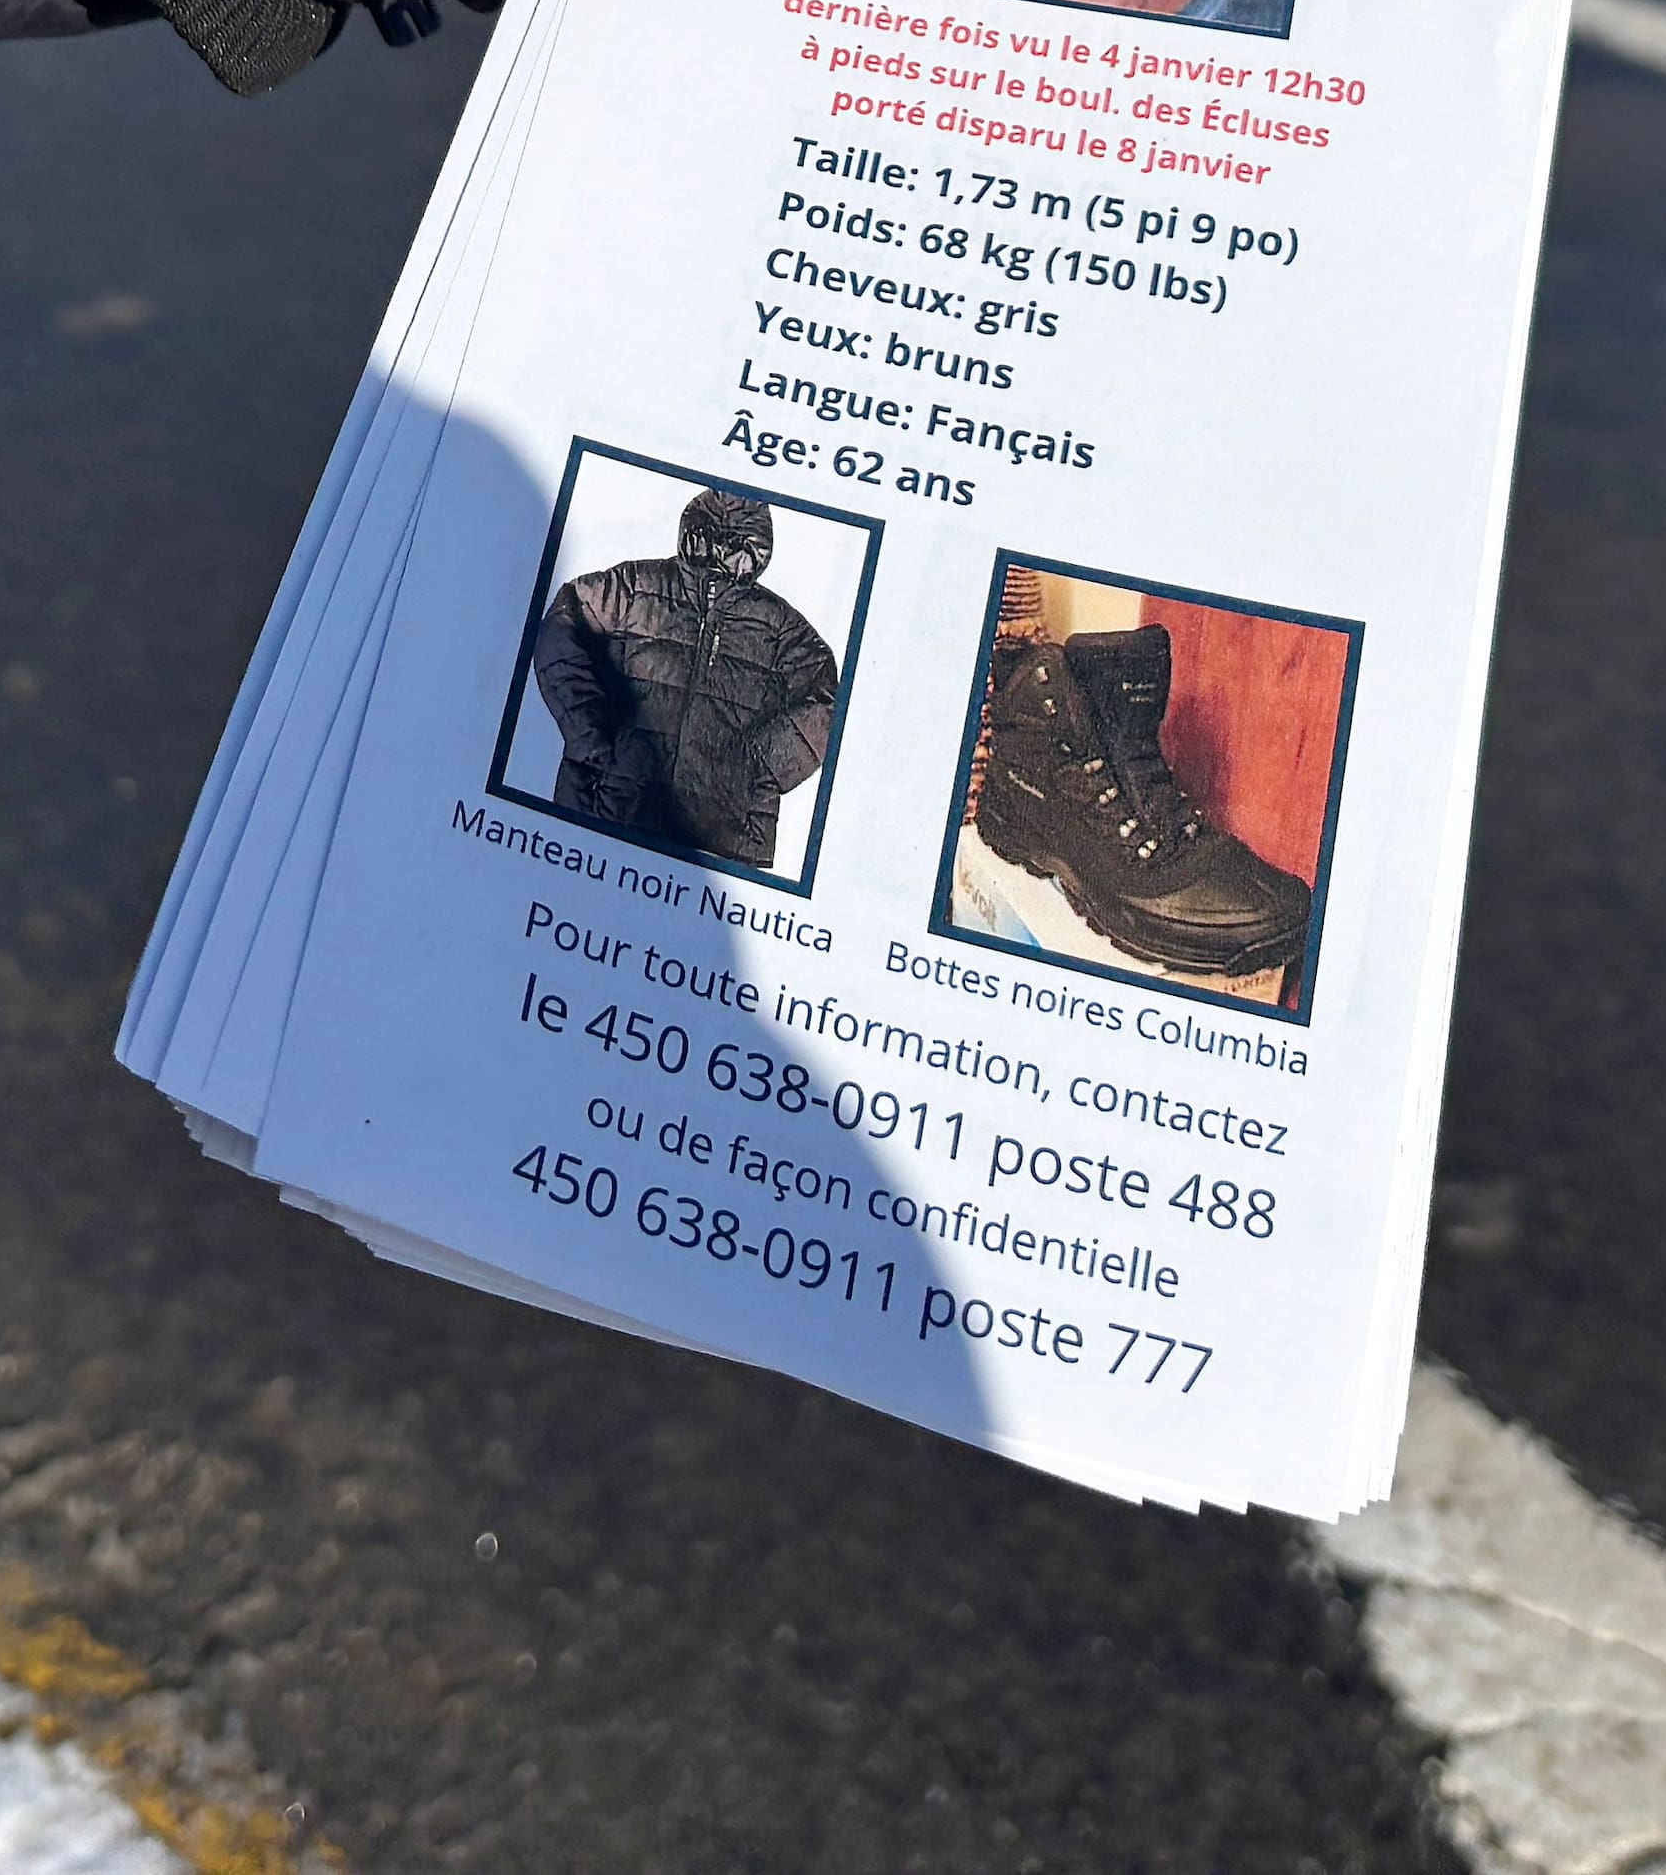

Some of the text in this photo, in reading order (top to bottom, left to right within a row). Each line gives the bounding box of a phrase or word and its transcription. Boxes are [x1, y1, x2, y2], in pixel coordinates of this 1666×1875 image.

[800, 34, 1330, 148] à pieds sur le boul. des Écluses
[939, 16, 1001, 50] fois
[1009, 33, 1051, 58] vu
[1060, 34, 1091, 65] le
[1099, 43, 1121, 69] 4
[1123, 45, 1253, 89] janvier
[1264, 67, 1366, 106] 12h30
[830, 91, 1272, 185] porté disparu le 8 janvier
[777, 190, 1227, 315] Poids: 68 kg (150 lbs)
[792, 135, 1299, 267] Taille: 1,73 m (5 pi 9 po)
[754, 300, 1015, 390] Yeux: bruns
[766, 247, 1060, 338] Cheveux: gris
[720, 408, 977, 507] Âge: 62 ans
[738, 358, 1096, 470] Langue: Fançais
[451, 799, 833, 954] Manteau noir Nautica
[524, 900, 1289, 1157] Pour toute information, contactez
[885, 940, 1308, 1077] Bottes noires Columbia
[520, 972, 1276, 1239] le 450 638-0911 poste 488
[587, 1097, 1179, 1299] ou de façon confidentielle
[512, 1145, 1214, 1394] 450 638-0911 poste 777
